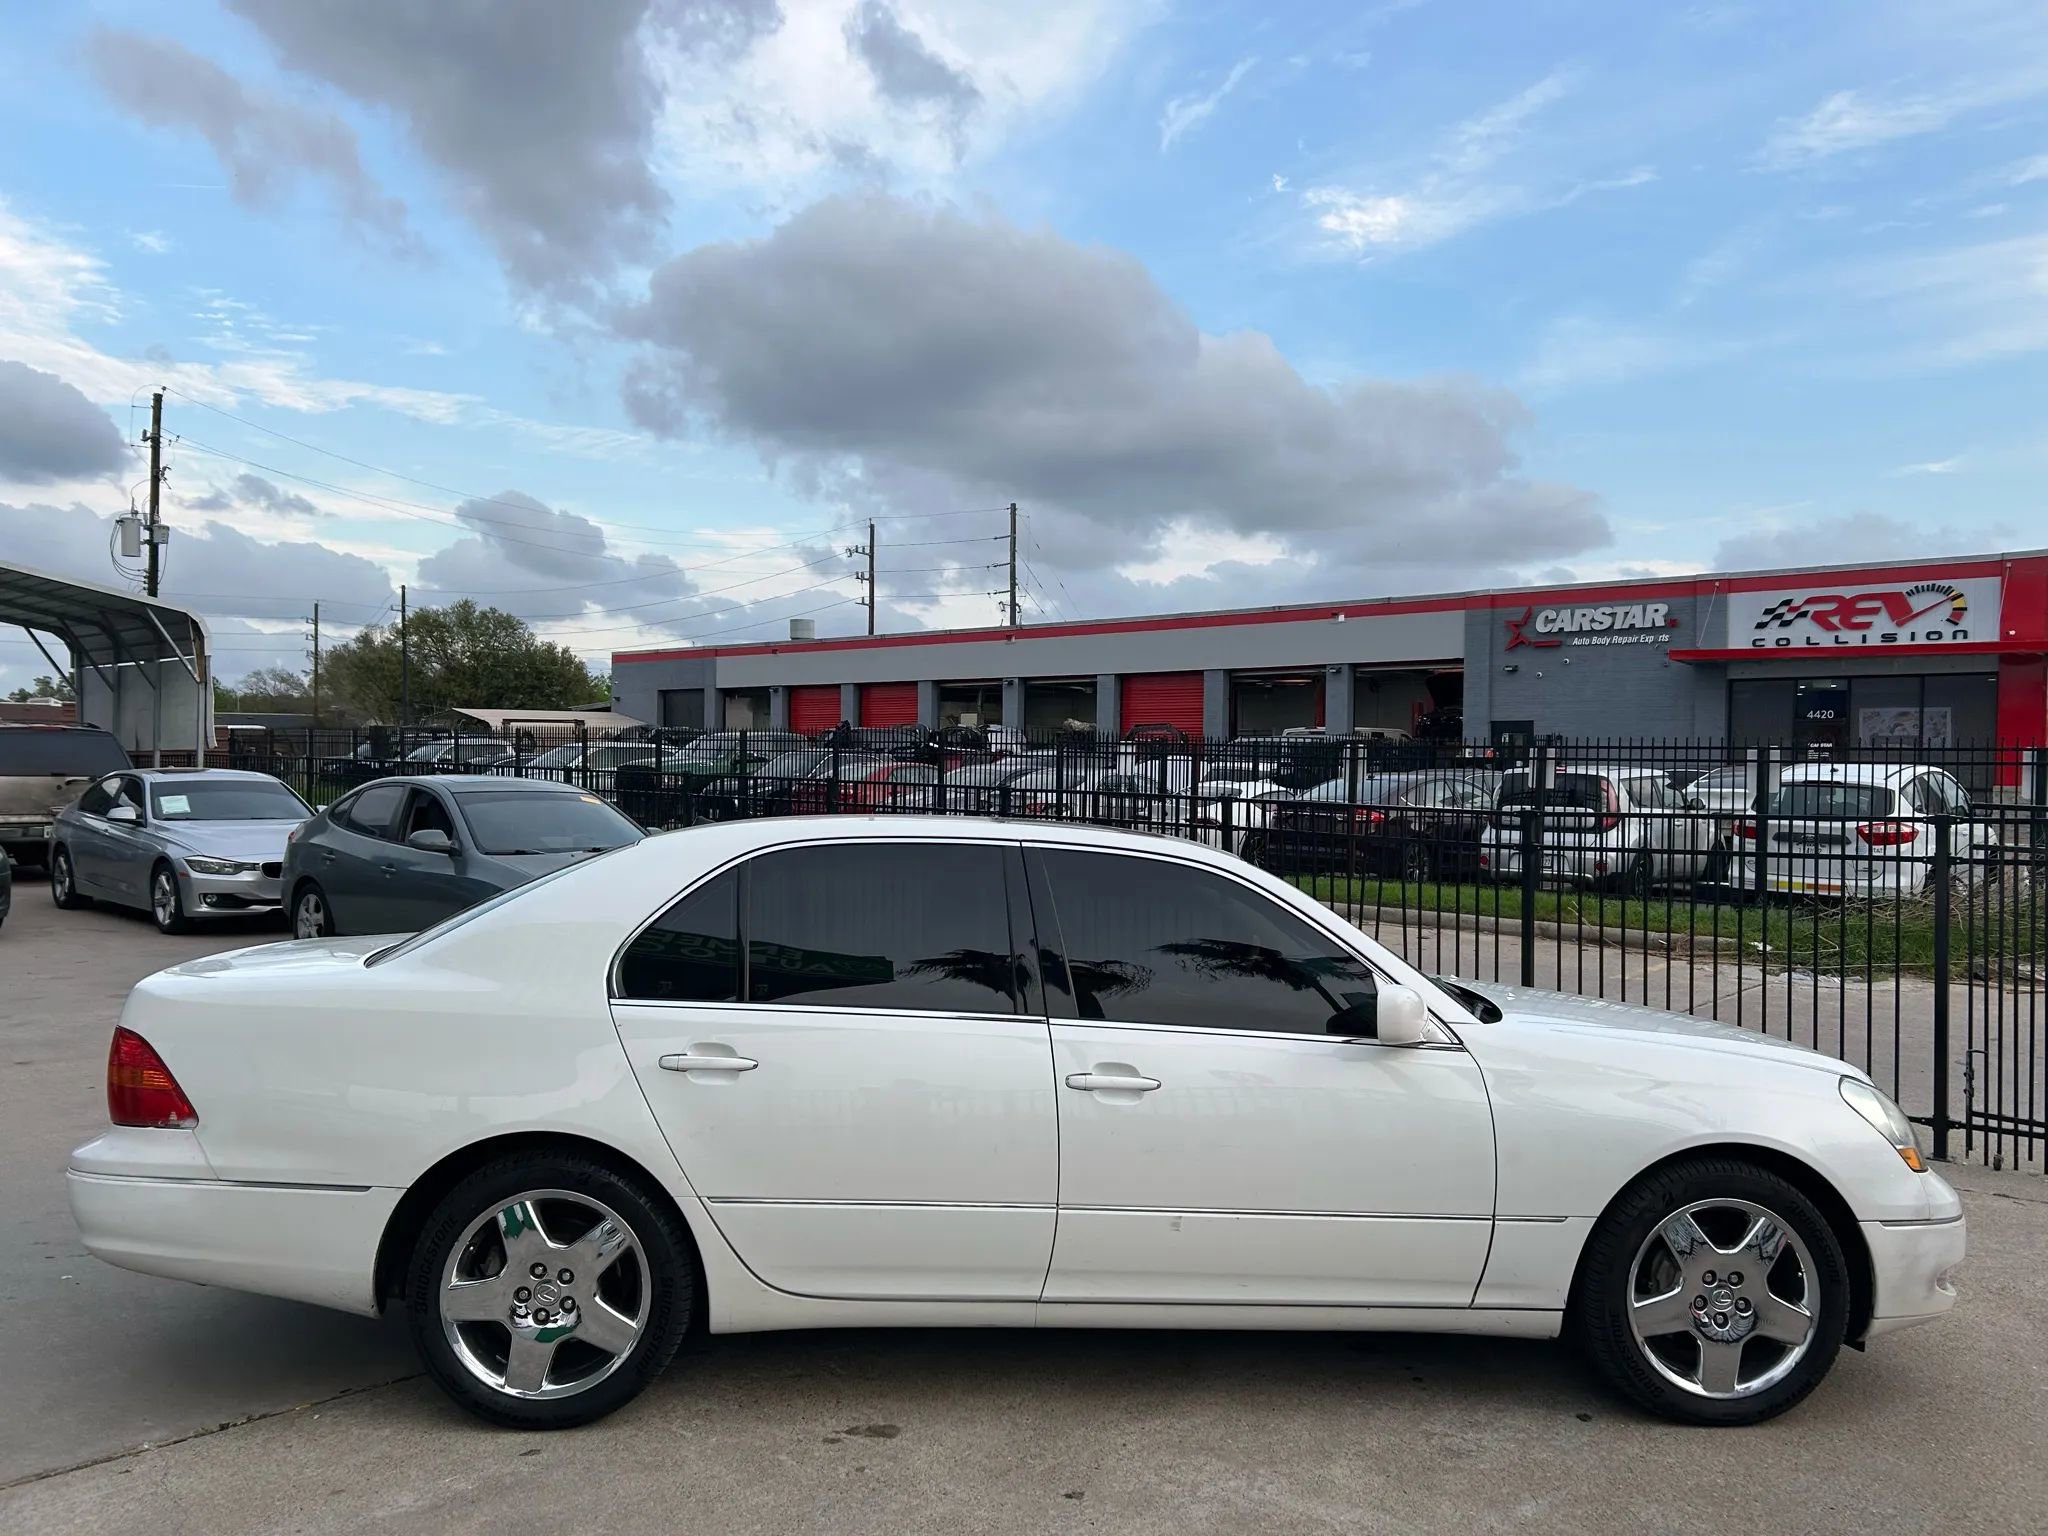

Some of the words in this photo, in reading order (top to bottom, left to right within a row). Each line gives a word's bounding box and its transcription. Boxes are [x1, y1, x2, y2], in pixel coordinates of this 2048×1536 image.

[1535, 603, 1669, 633] CARSTAR
[1794, 591, 1914, 631] REV
[1572, 636, 1590, 646] Auto
[1591, 635, 1611, 647] Body
[1611, 635, 1639, 646] Repair
[1640, 634, 1670, 645] Exprts
[1751, 629, 1969, 648] COLLISION
[1806, 710, 1834, 719] 4420
[1790, 1201, 1841, 1283] BRIDGESTONE
[415, 1215, 458, 1315] BRIDGESTONE
